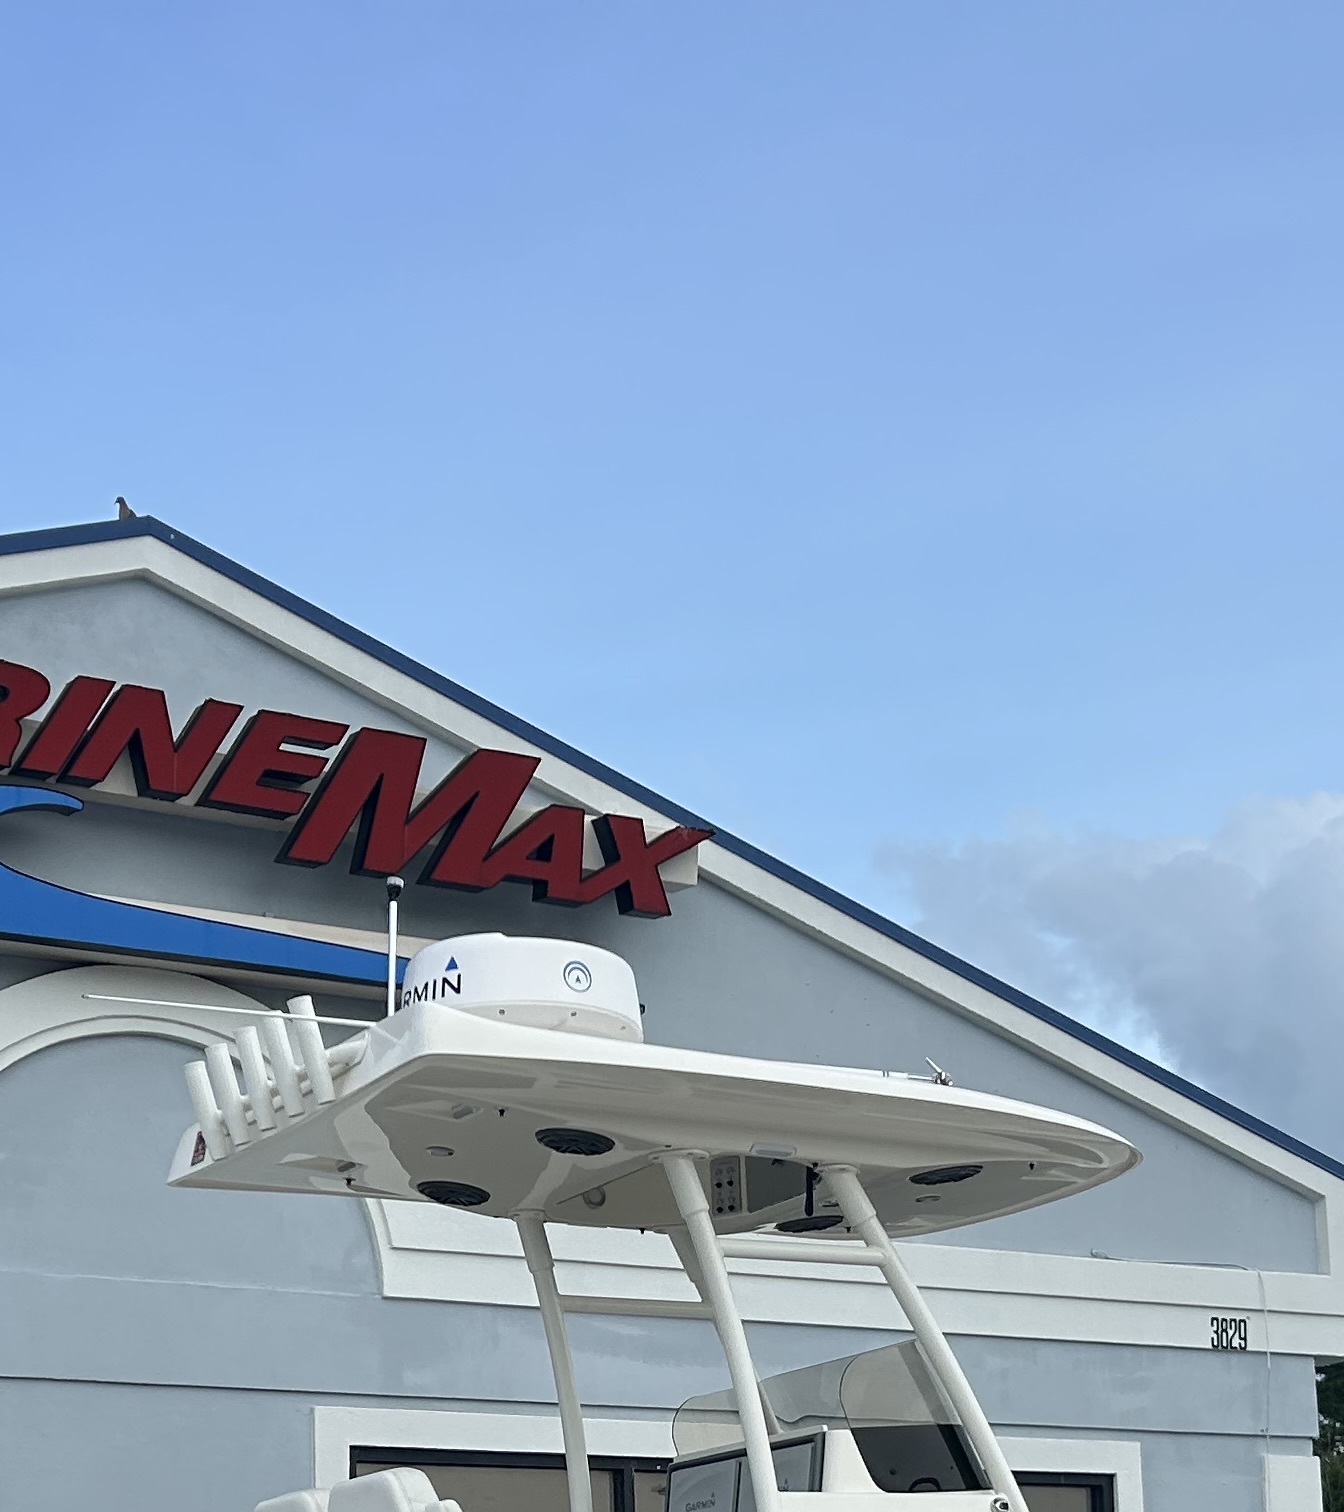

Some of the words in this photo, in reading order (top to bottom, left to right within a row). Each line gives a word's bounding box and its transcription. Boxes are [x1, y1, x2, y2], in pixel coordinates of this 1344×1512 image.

[403, 973, 461, 1009] RMIN
[1211, 1316, 1247, 1350] 3829
[685, 1499, 716, 1512] GARMIN
